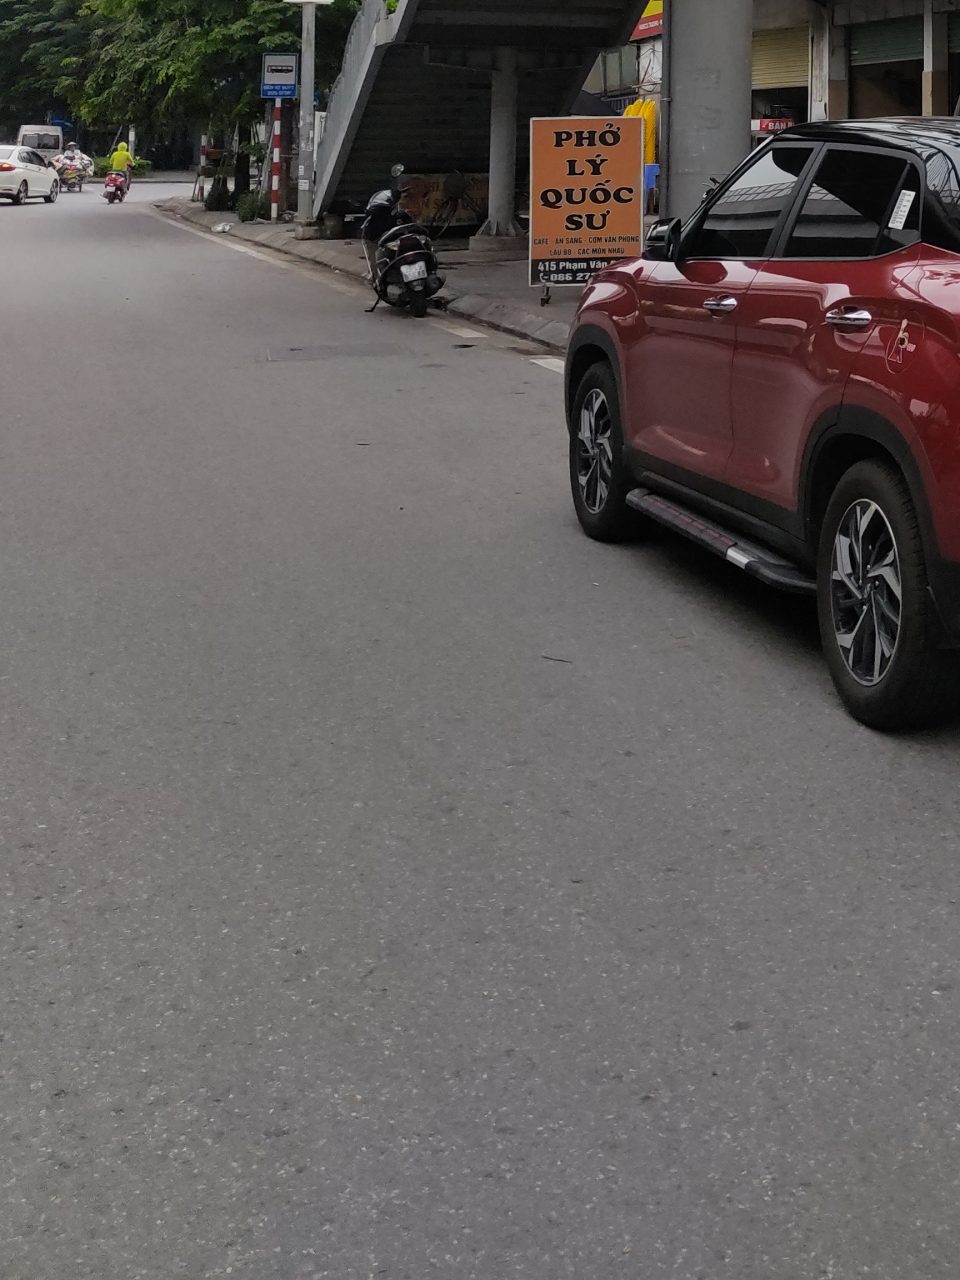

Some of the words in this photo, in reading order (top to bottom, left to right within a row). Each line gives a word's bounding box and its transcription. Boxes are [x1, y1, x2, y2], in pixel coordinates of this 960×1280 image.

[554, 123, 621, 148] PHỞ
[566, 154, 608, 176] LÝ
[540, 179, 634, 209] QUỐC
[565, 210, 610, 231] SƯ
[538, 261, 557, 272] 415
[559, 261, 587, 272] Phạm
[550, 272, 573, 281] 086
